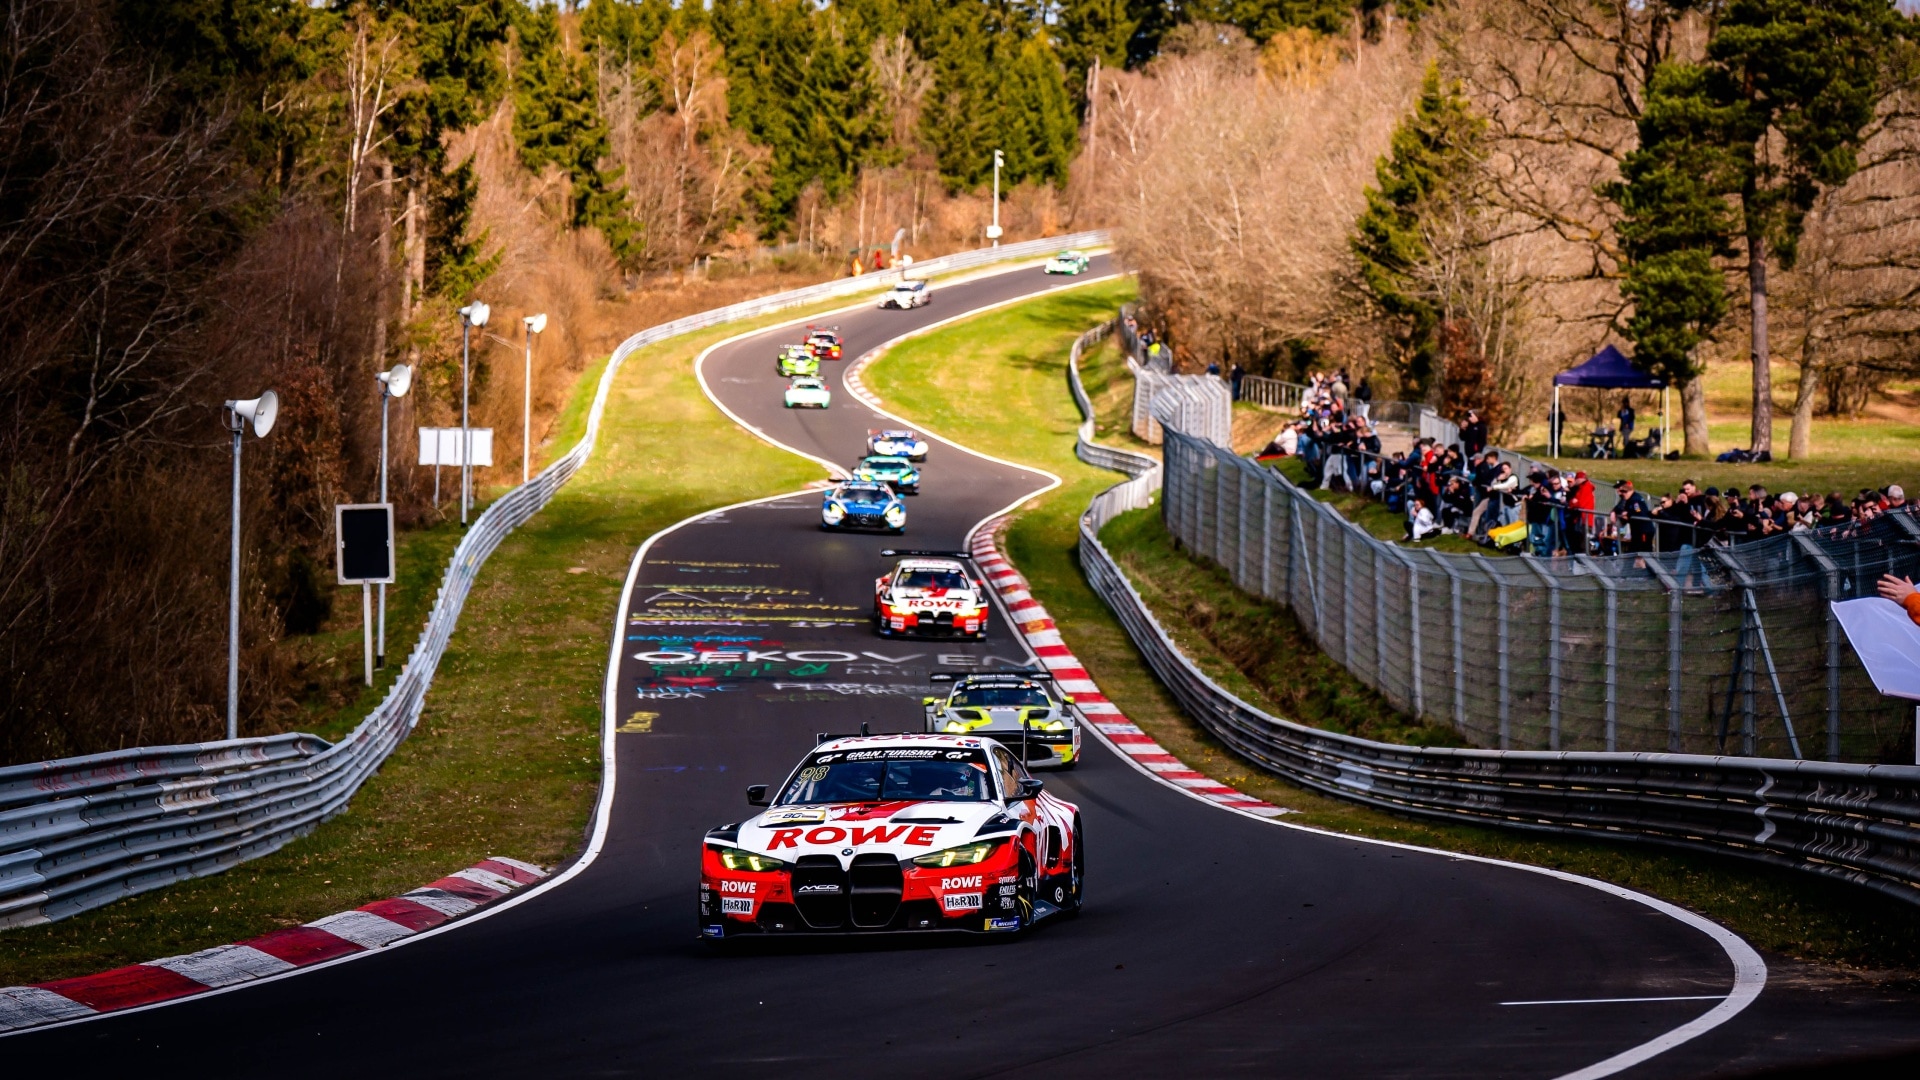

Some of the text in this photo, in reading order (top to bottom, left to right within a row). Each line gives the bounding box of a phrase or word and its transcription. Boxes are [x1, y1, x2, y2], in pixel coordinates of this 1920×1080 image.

[908, 600, 964, 609] ROWE
[846, 750, 882, 759] GRAN
[800, 765, 830, 784] 98
[767, 825, 942, 851] ROWE
[721, 880, 757, 894] ROWE
[941, 876, 983, 890] ROWE
